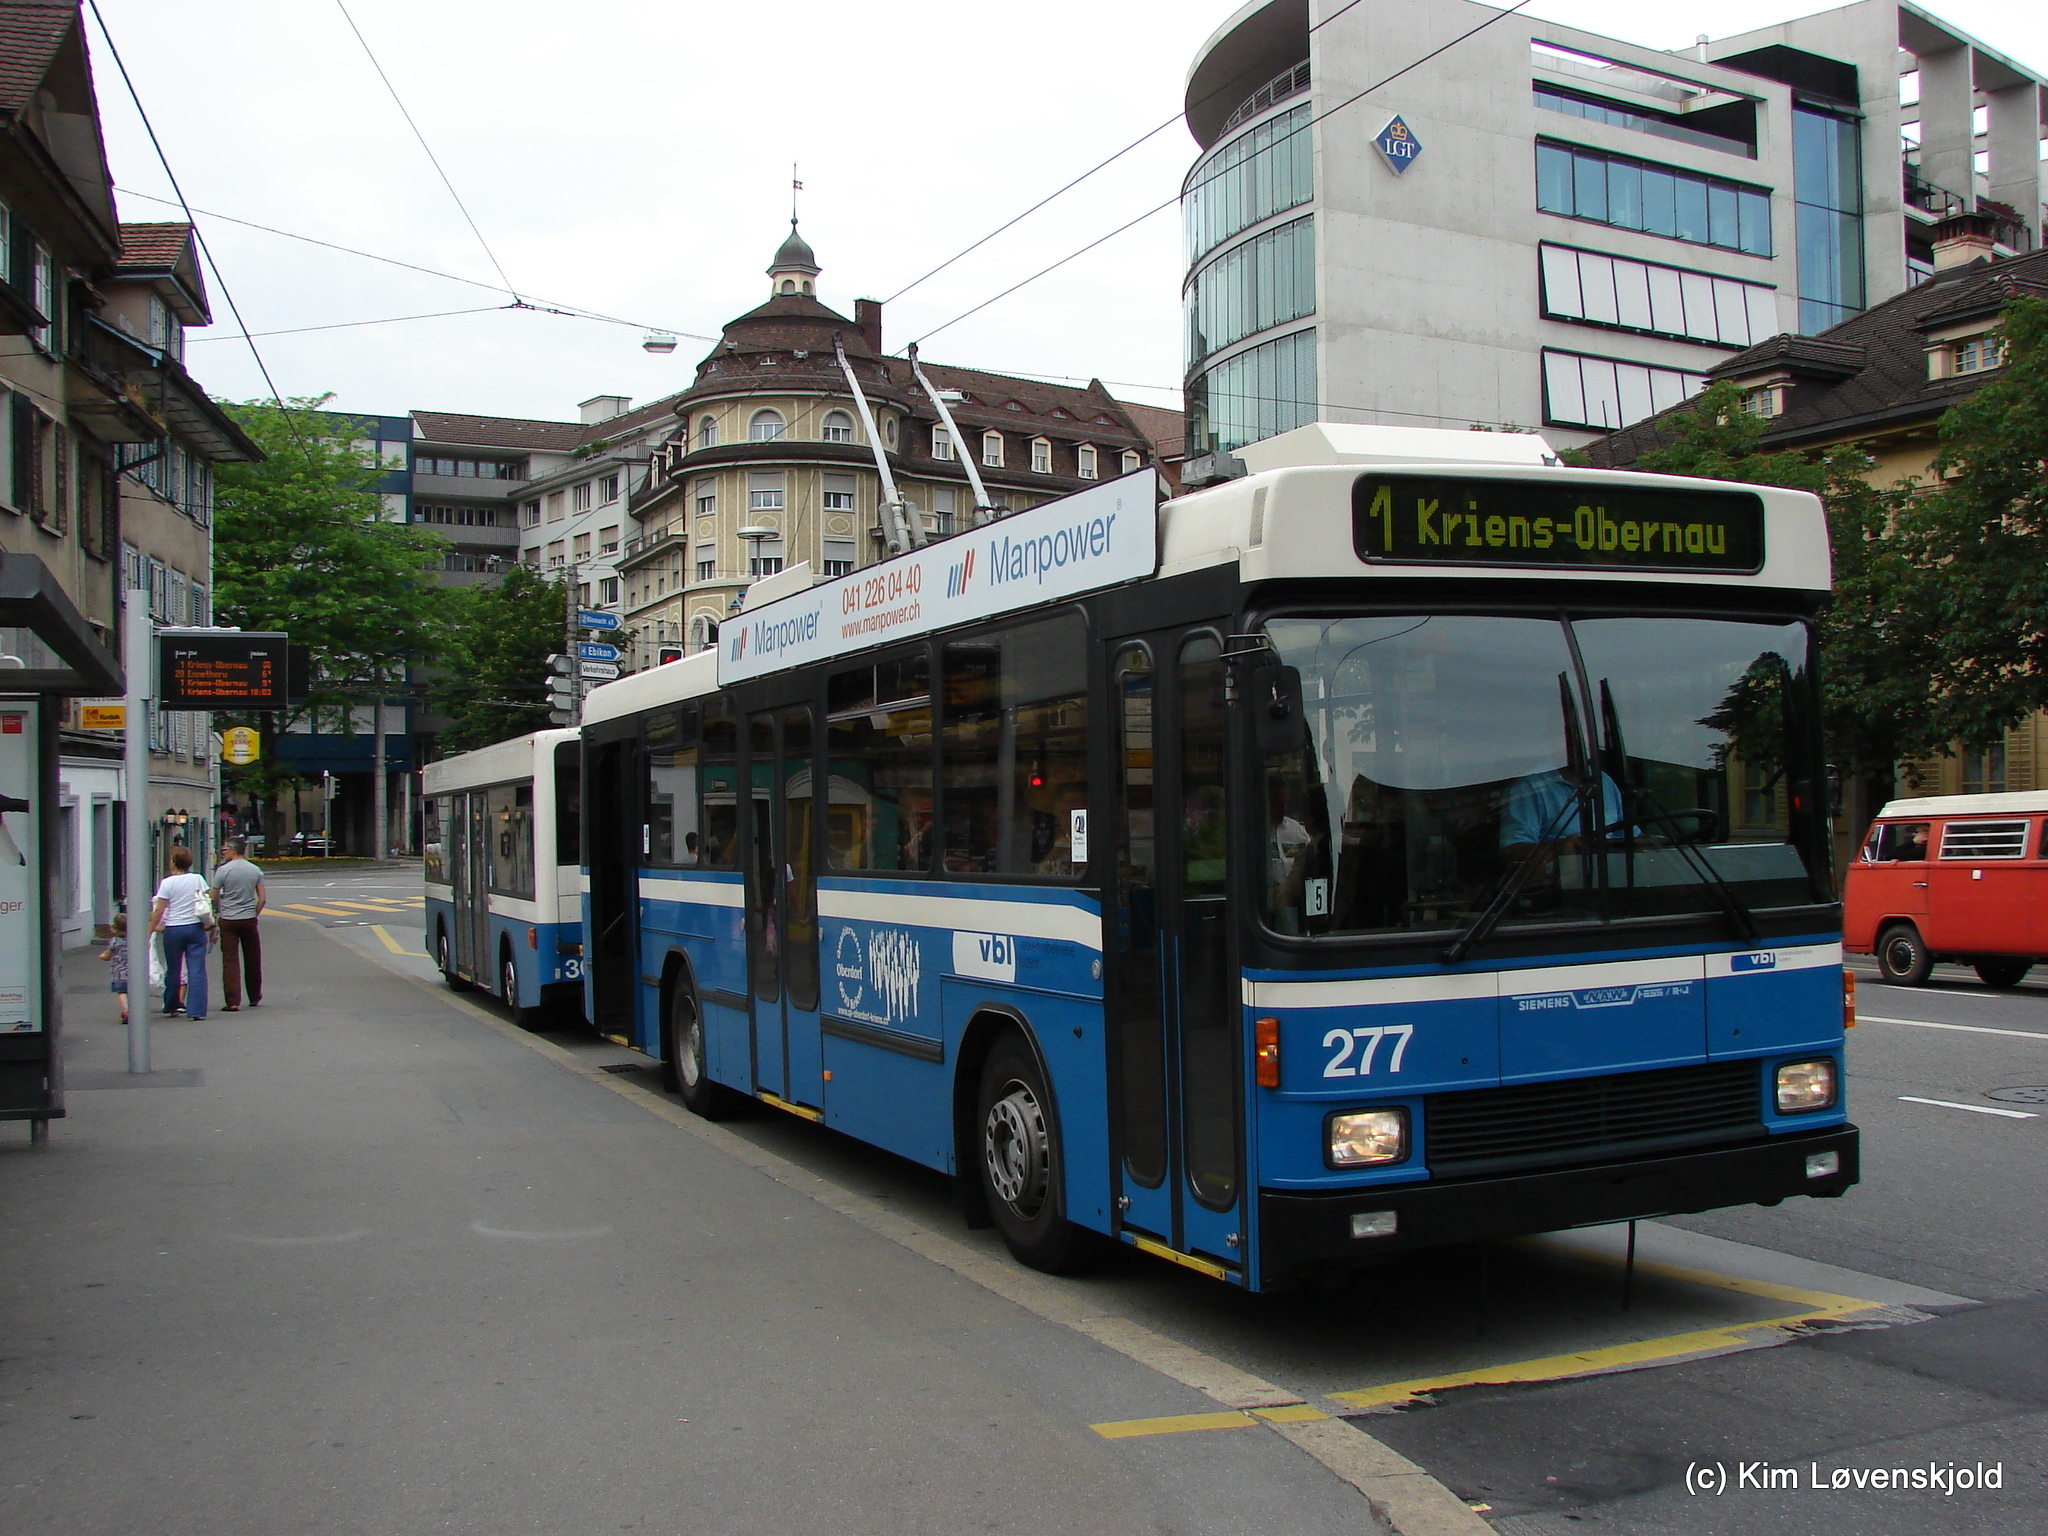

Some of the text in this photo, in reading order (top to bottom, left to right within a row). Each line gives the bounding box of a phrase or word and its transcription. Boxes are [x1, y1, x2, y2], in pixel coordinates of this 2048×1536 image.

[1385, 138, 1415, 159] LGT
[1369, 485, 1725, 555] 1 Kriens-Obernau
[990, 513, 1116, 586] Manpower
[842, 563, 921, 615] 041 226 04 40
[841, 598, 921, 640] www.manpower.ch
[755, 610, 820, 658] Manpower
[588, 647, 612, 657] Ebikon
[187, 661, 248, 669] Kriens-Obernau
[582, 665, 616, 675] Verkehrshaus
[187, 679, 248, 687] Kriens-Obernau
[187, 688, 248, 696] Kriens-Obernau
[1315, 885, 1322, 911] 5
[979, 934, 1012, 965] vbl
[1750, 951, 1774, 965] vbl
[837, 963, 863, 980] Oberdorf
[1518, 996, 1570, 1012] SIEMENS
[1586, 988, 1624, 1003] NAW
[1322, 1024, 1414, 1078] 277
